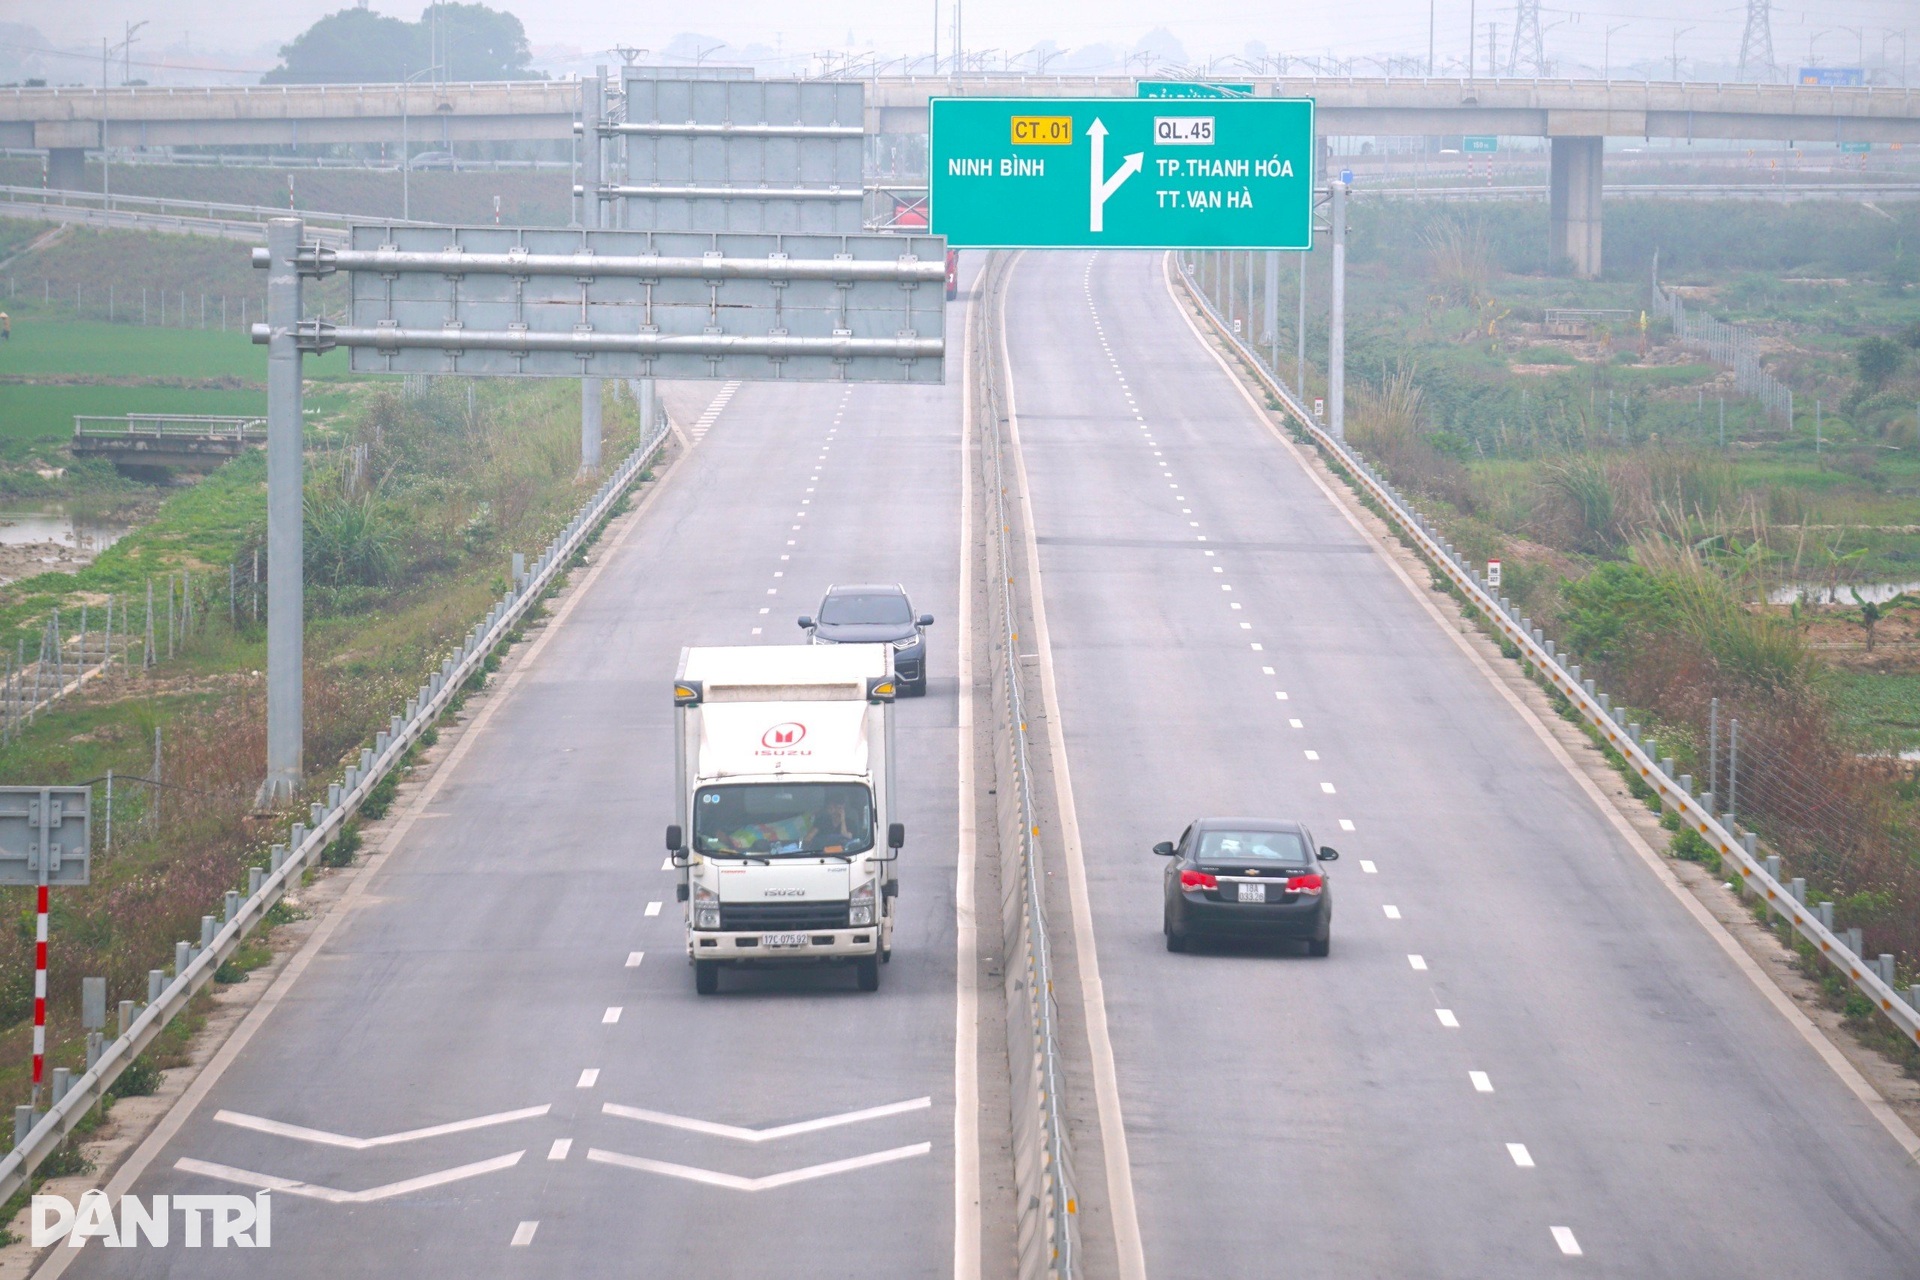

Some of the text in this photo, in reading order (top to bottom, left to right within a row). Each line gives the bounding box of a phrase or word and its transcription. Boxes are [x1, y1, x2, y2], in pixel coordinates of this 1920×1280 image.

[1015, 121, 1068, 139] CT.01
[1158, 121, 1211, 139] QL.45
[948, 153, 1044, 177] NINH BÌNH
[1156, 153, 1294, 177] TP.THANH HÓA
[1156, 185, 1253, 213] TT.VẠN HÀ
[764, 887, 805, 897] ISUZU
